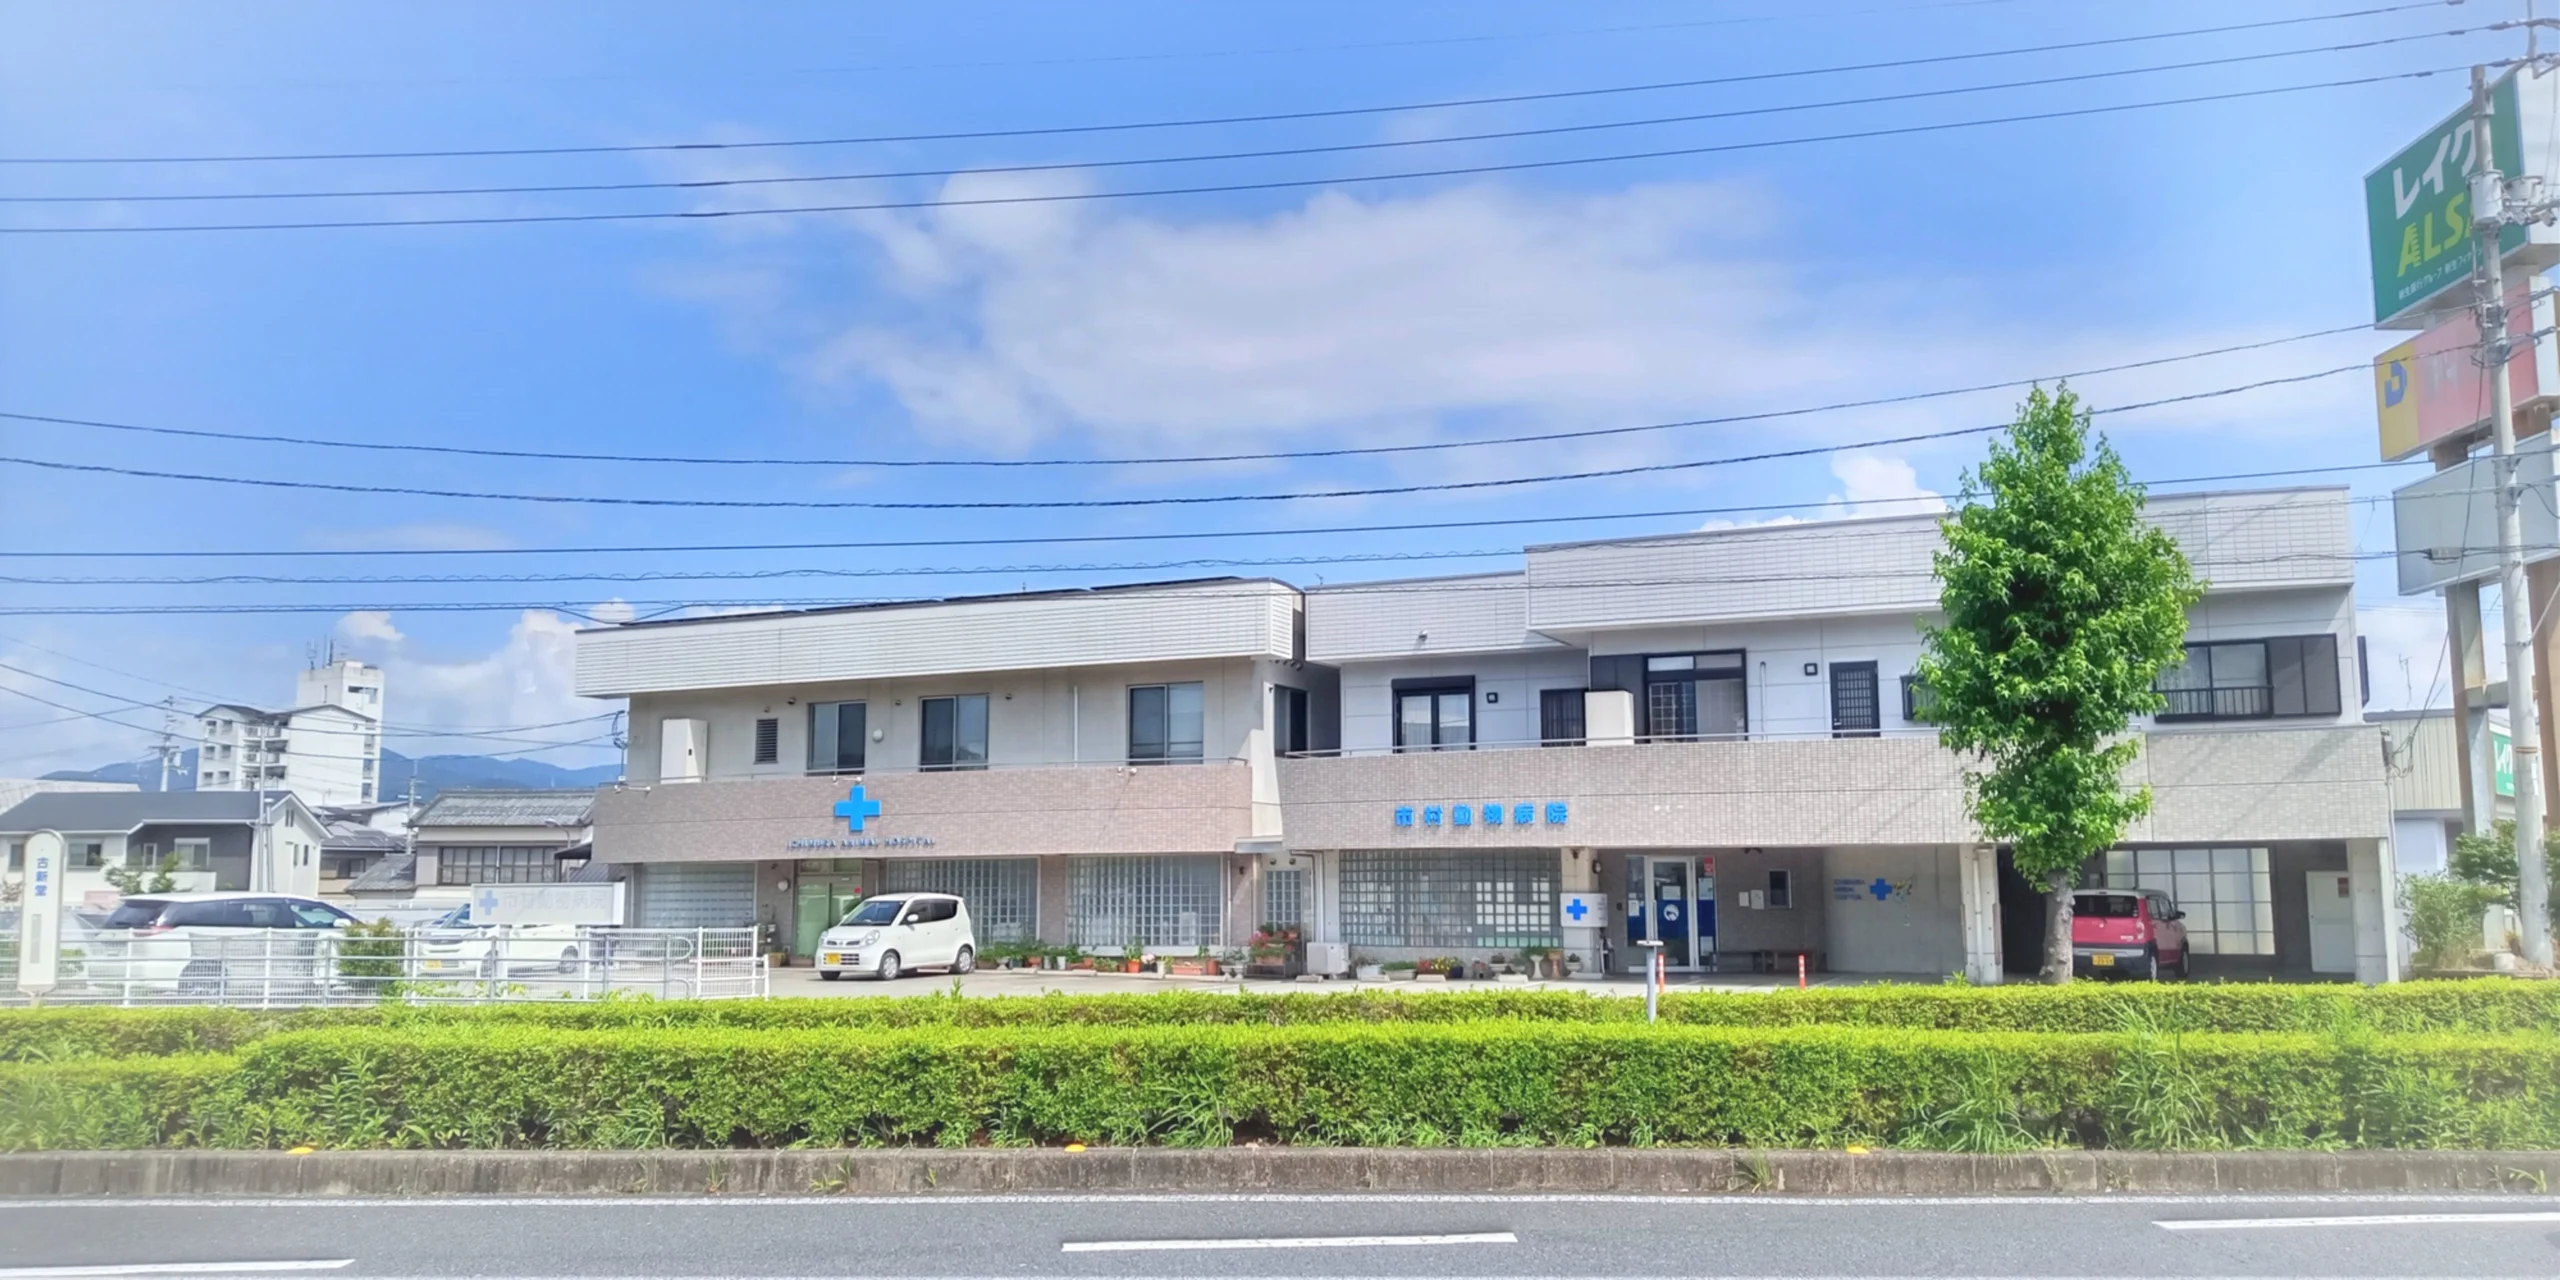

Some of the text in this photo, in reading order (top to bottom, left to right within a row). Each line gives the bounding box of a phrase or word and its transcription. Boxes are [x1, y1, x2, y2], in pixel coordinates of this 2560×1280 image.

[2393, 119, 2477, 220] レイク
[2397, 191, 2473, 278] ALS
[841, 837, 879, 848] ANIMAL
[884, 835, 936, 848] HOSPITAL
[1395, 802, 1568, 827] 市村動物病院
